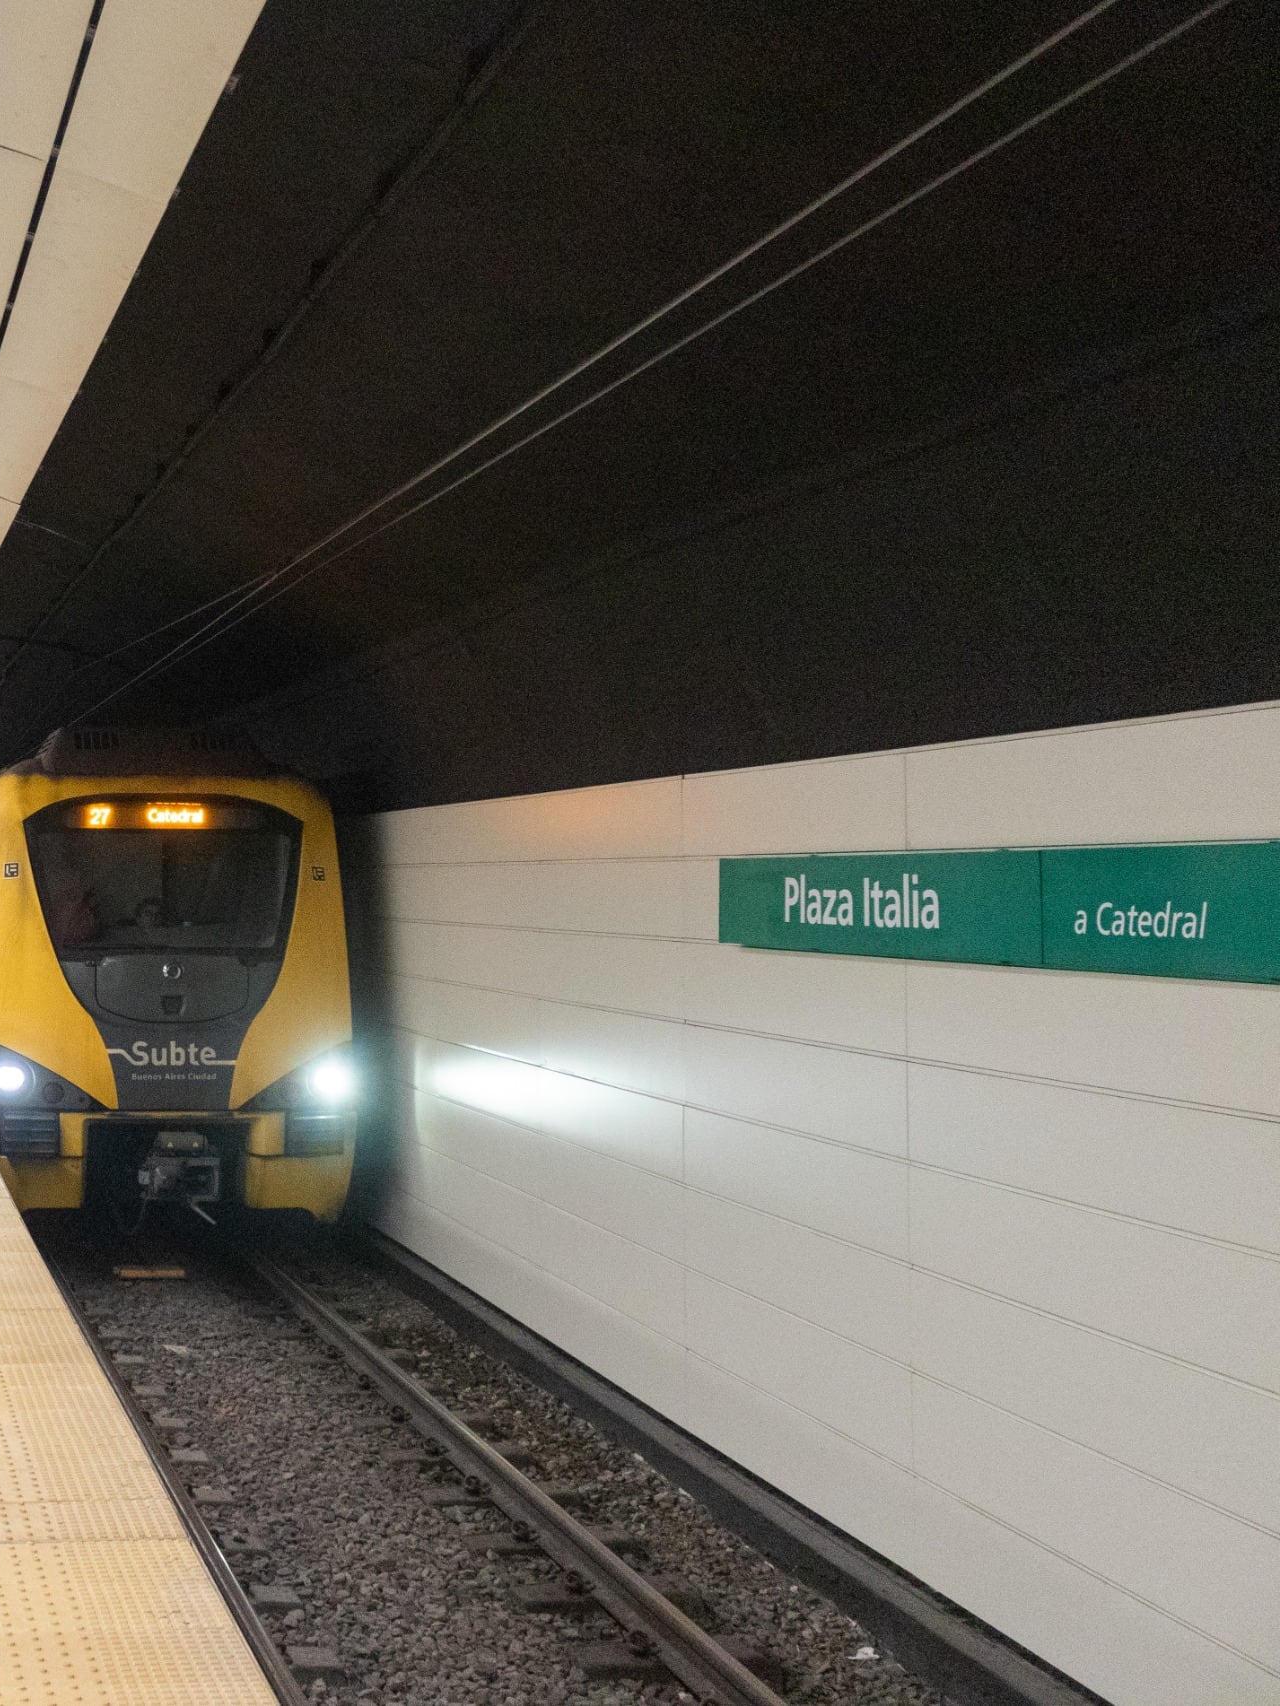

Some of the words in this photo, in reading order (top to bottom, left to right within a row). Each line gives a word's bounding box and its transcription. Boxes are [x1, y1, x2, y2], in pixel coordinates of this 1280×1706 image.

[89, 807, 111, 825] 27
[147, 808, 204, 824] Catedral
[784, 873, 854, 926] Plaza
[863, 872, 940, 929] Italia
[1074, 910, 1087, 935] a
[1096, 901, 1207, 939] Catedral
[131, 1040, 217, 1066] Subte
[131, 1072, 162, 1081] Buenos
[165, 1072, 186, 1081] Aires
[187, 1072, 217, 1081] Ciudad
